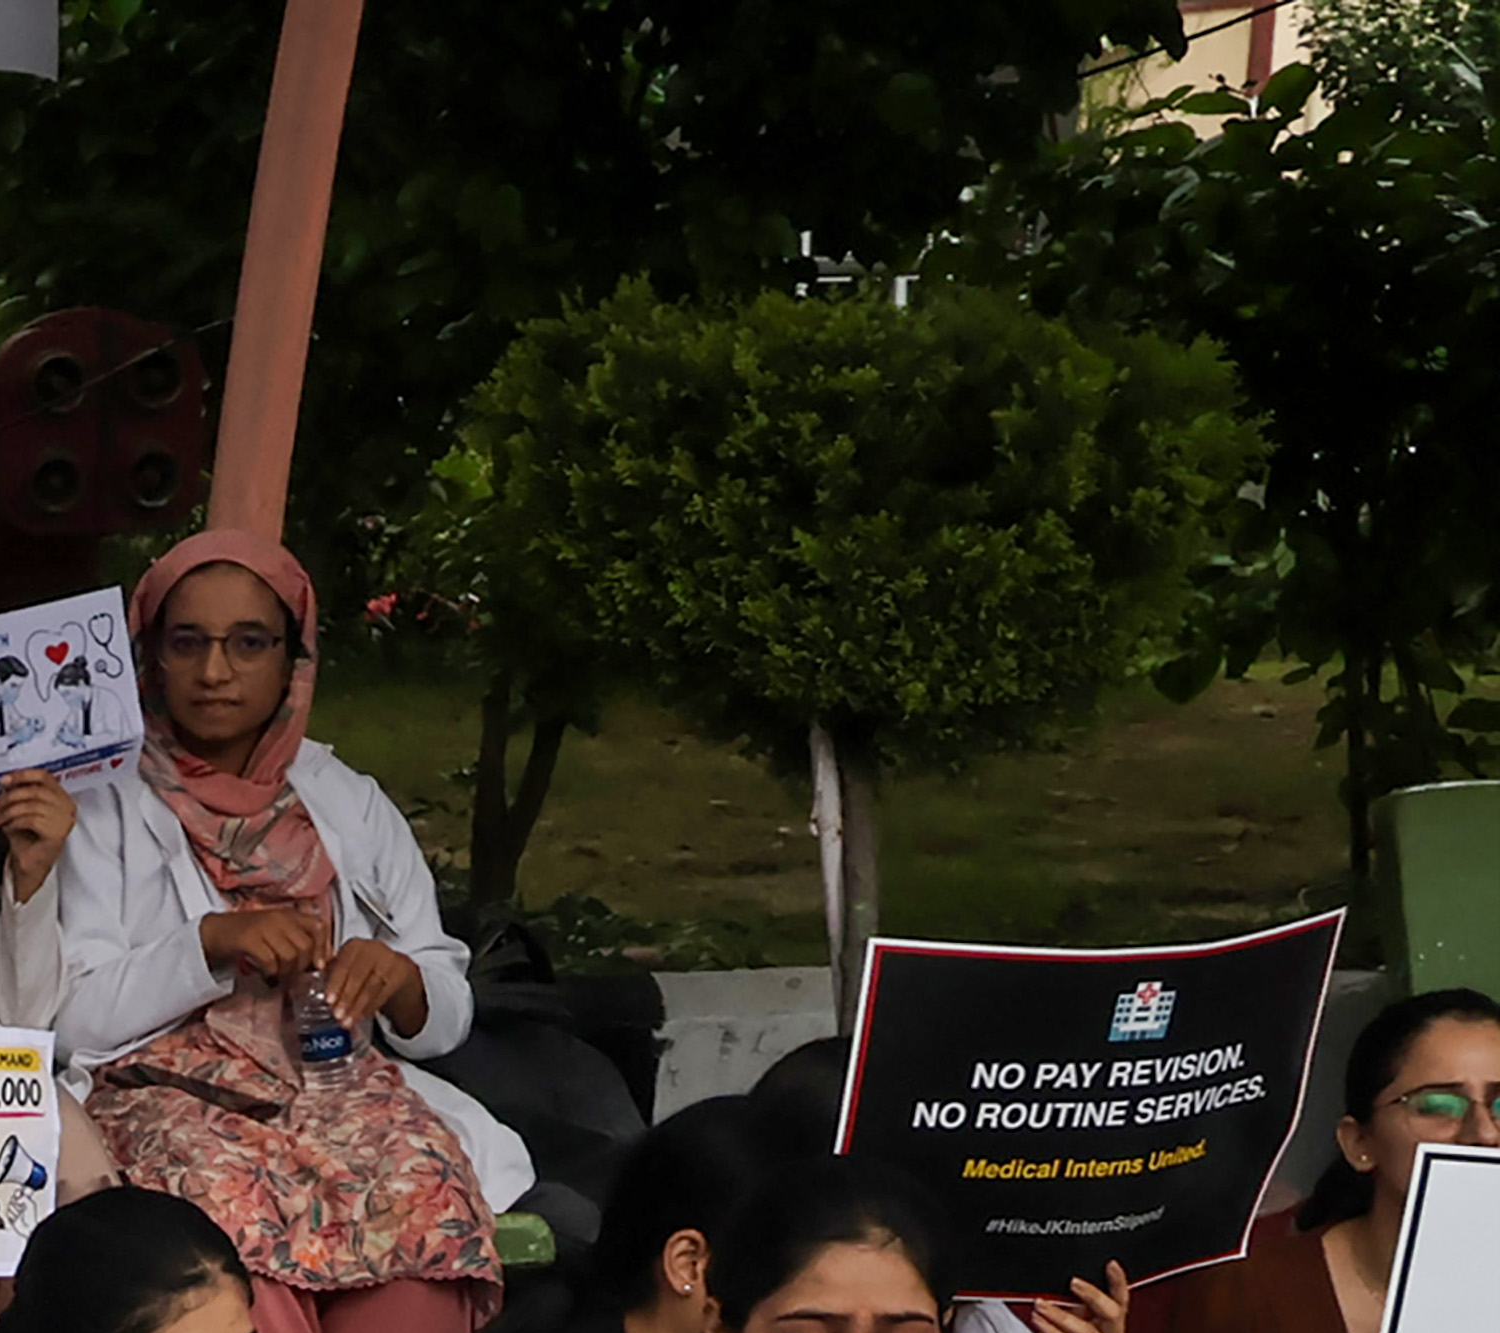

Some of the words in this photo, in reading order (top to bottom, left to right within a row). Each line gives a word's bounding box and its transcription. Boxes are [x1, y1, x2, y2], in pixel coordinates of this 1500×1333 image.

[971, 1062, 1027, 1090] NO
[1033, 1061, 1102, 1090] PAY
[1108, 1043, 1246, 1088] REVISION.
[912, 1101, 968, 1129] NO
[974, 1100, 1128, 1130] ROUTINE
[1134, 1075, 1266, 1125] SERVICES.
[962, 1156, 1061, 1181] Medical
[1064, 1154, 1144, 1179] Interns
